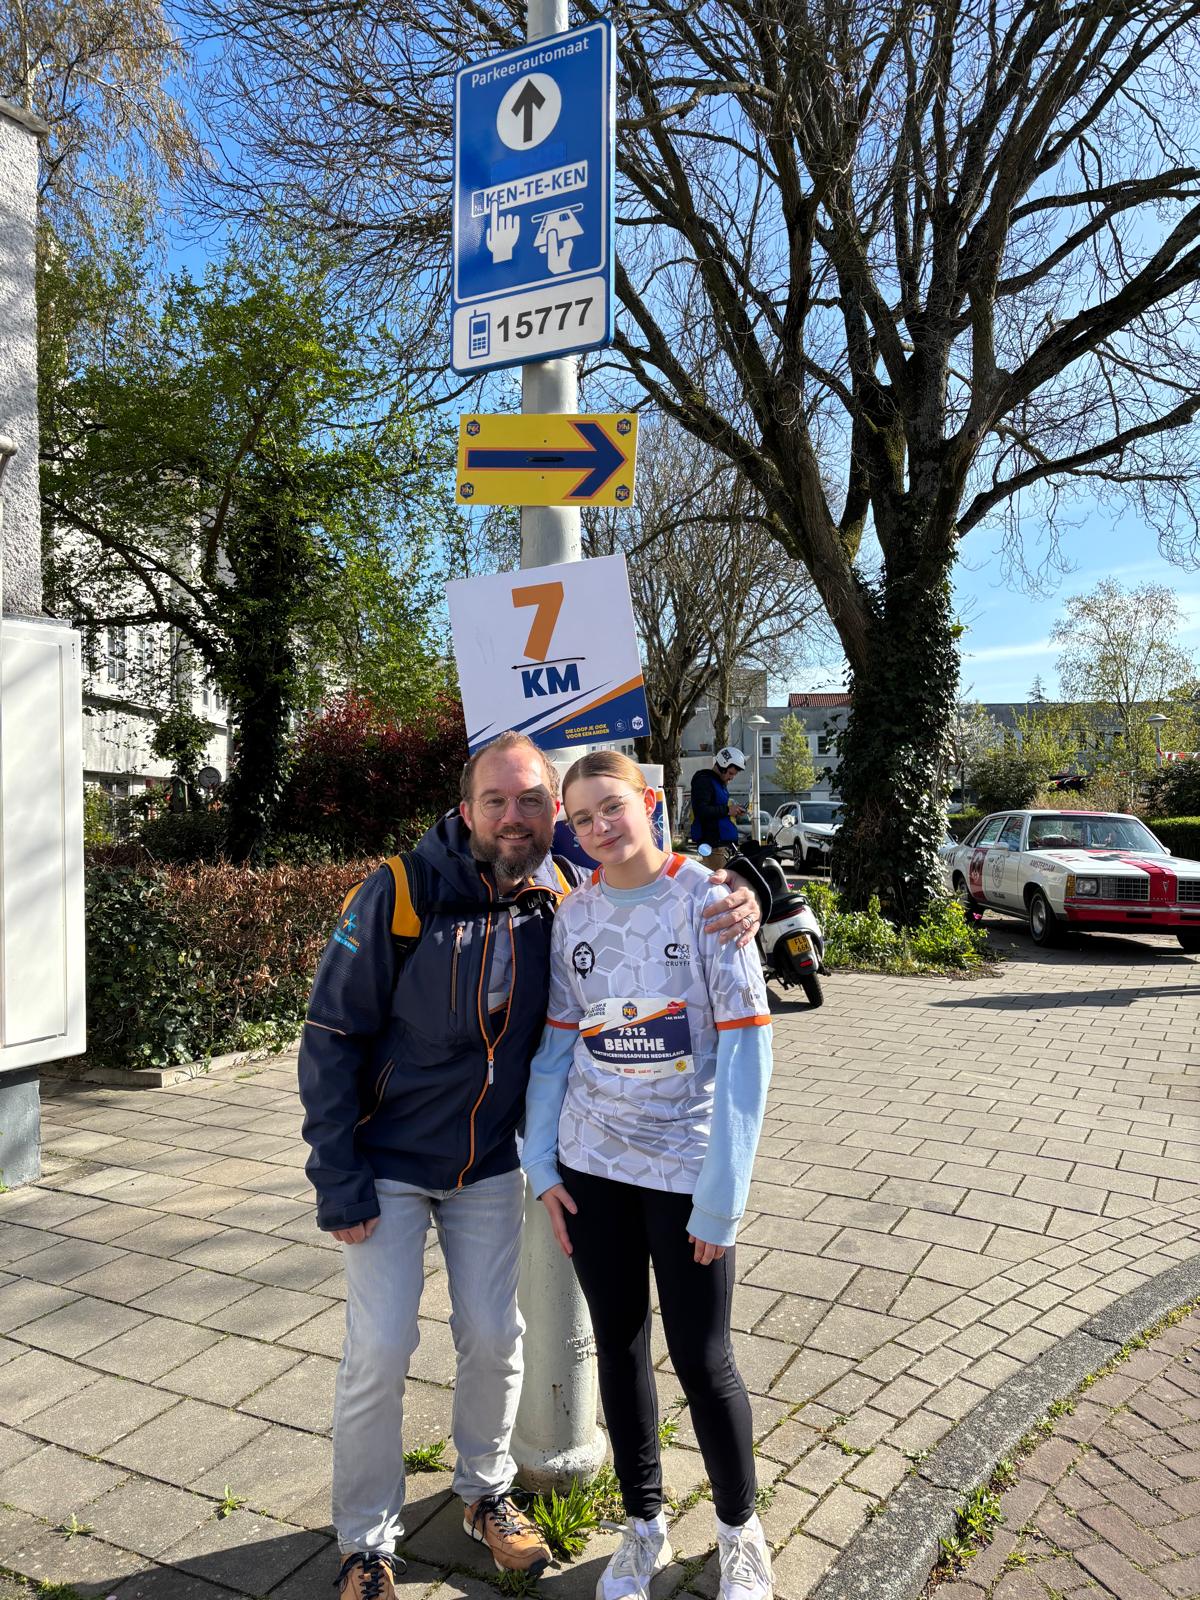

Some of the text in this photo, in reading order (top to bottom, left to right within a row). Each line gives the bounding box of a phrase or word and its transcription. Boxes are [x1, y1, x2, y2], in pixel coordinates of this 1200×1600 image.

[471, 36, 590, 88] Parkeerautomaat
[486, 166, 586, 209] KEN-TE-KEN
[497, 297, 593, 342] 15777
[511, 581, 564, 662] 7
[521, 663, 581, 699] KM
[604, 1038, 666, 1051] BENTHE
[619, 1027, 647, 1036] 7312
[592, 1049, 685, 1059] CERTIFICERINGSADVIES NEDERLAND
